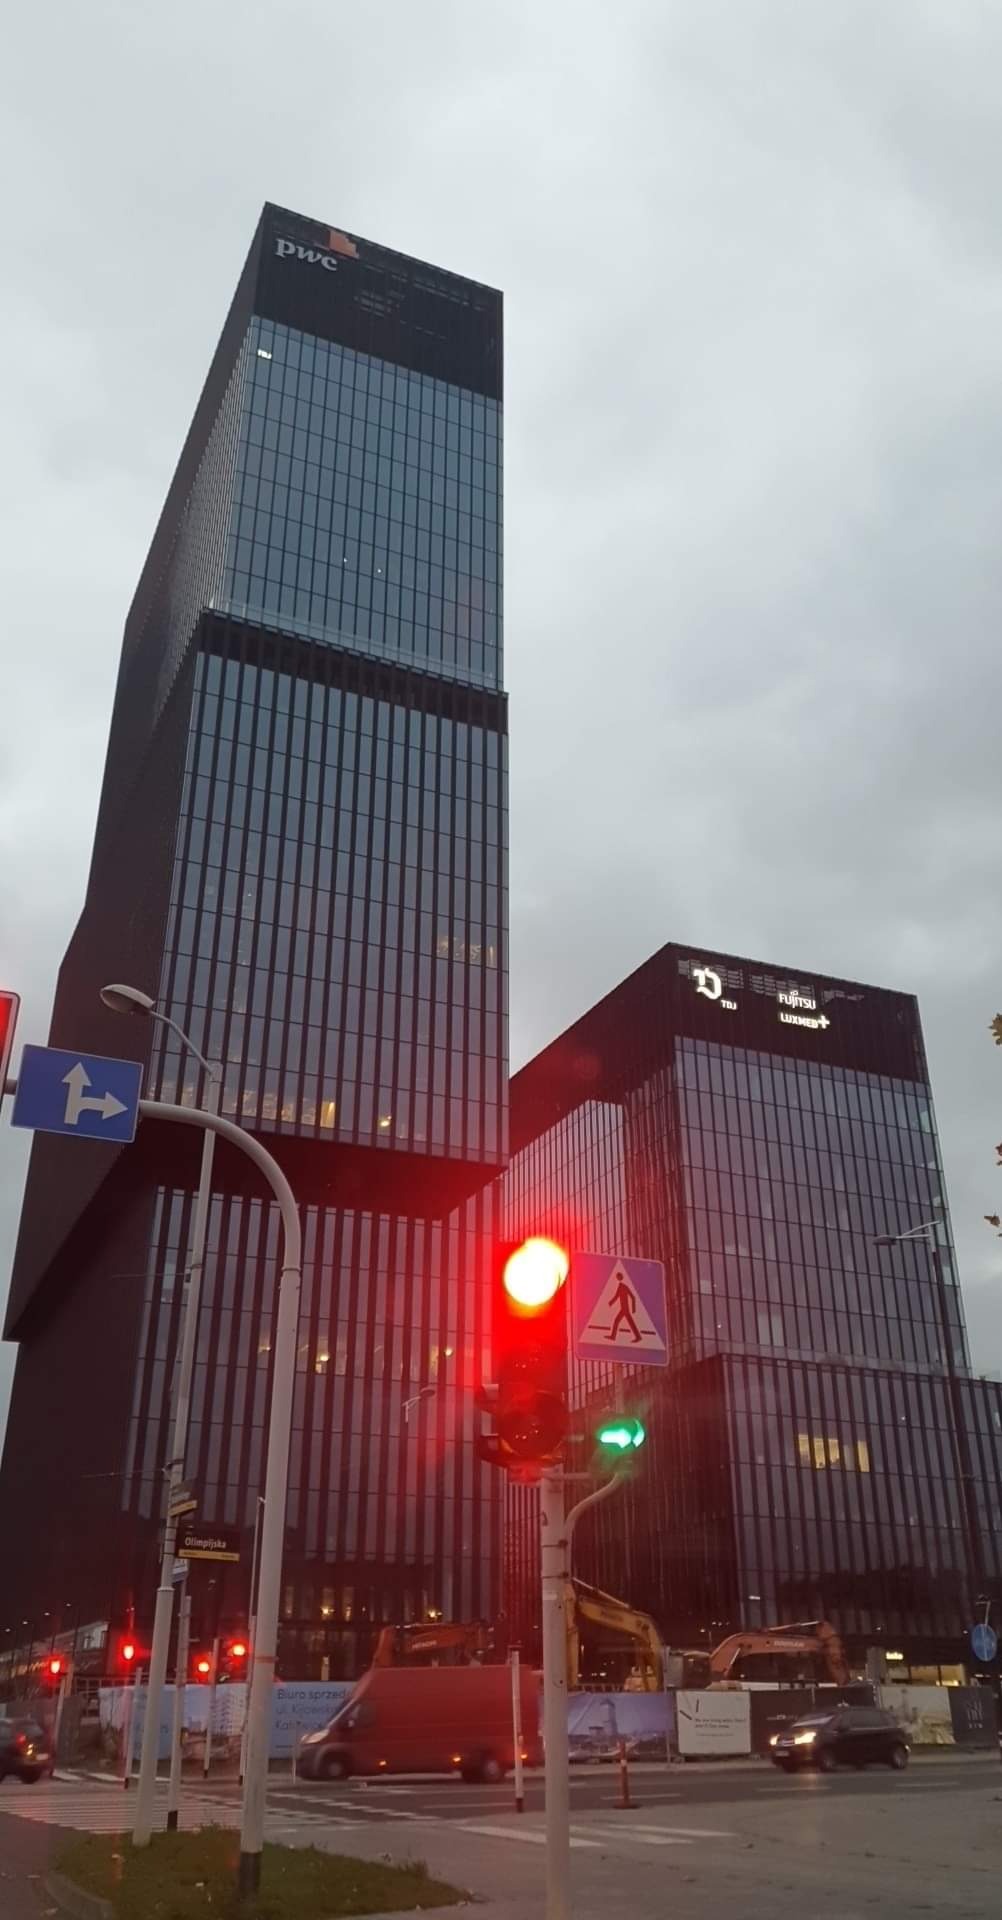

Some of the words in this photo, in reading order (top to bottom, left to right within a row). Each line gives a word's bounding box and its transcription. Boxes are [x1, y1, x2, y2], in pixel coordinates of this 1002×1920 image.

[275, 238, 337, 272] pwc
[720, 999, 737, 1010] TDJ
[779, 991, 817, 1010] FUJITSU
[184, 1536, 227, 1550] Olimpijska
[277, 1689, 305, 1699] Biuro
[309, 1689, 352, 1702] sprzed
